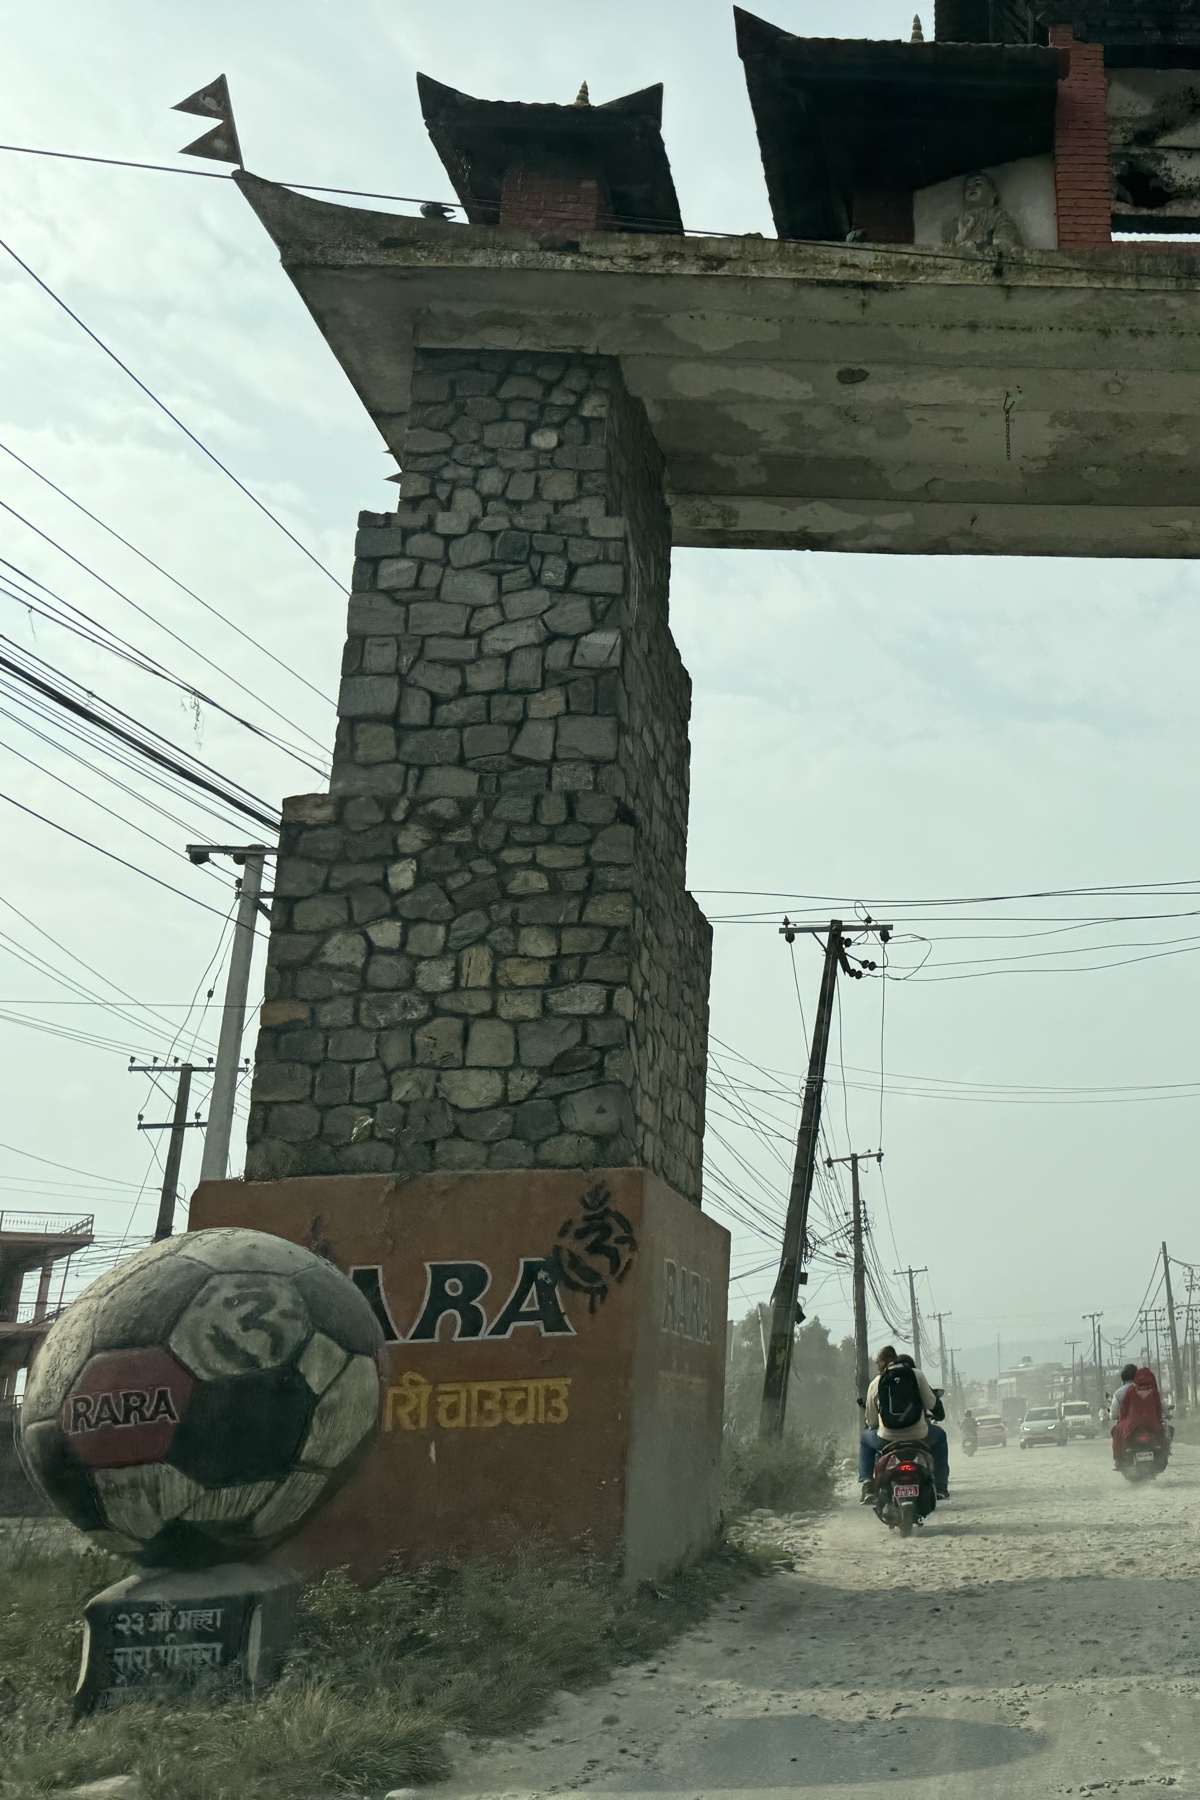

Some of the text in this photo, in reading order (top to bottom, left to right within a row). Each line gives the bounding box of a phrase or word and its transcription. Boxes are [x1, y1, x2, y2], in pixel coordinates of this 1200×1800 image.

[350, 1257, 577, 1345] ARA
[62, 1386, 180, 1435] RARA
[435, 1378, 572, 1428] चाउचाउ
